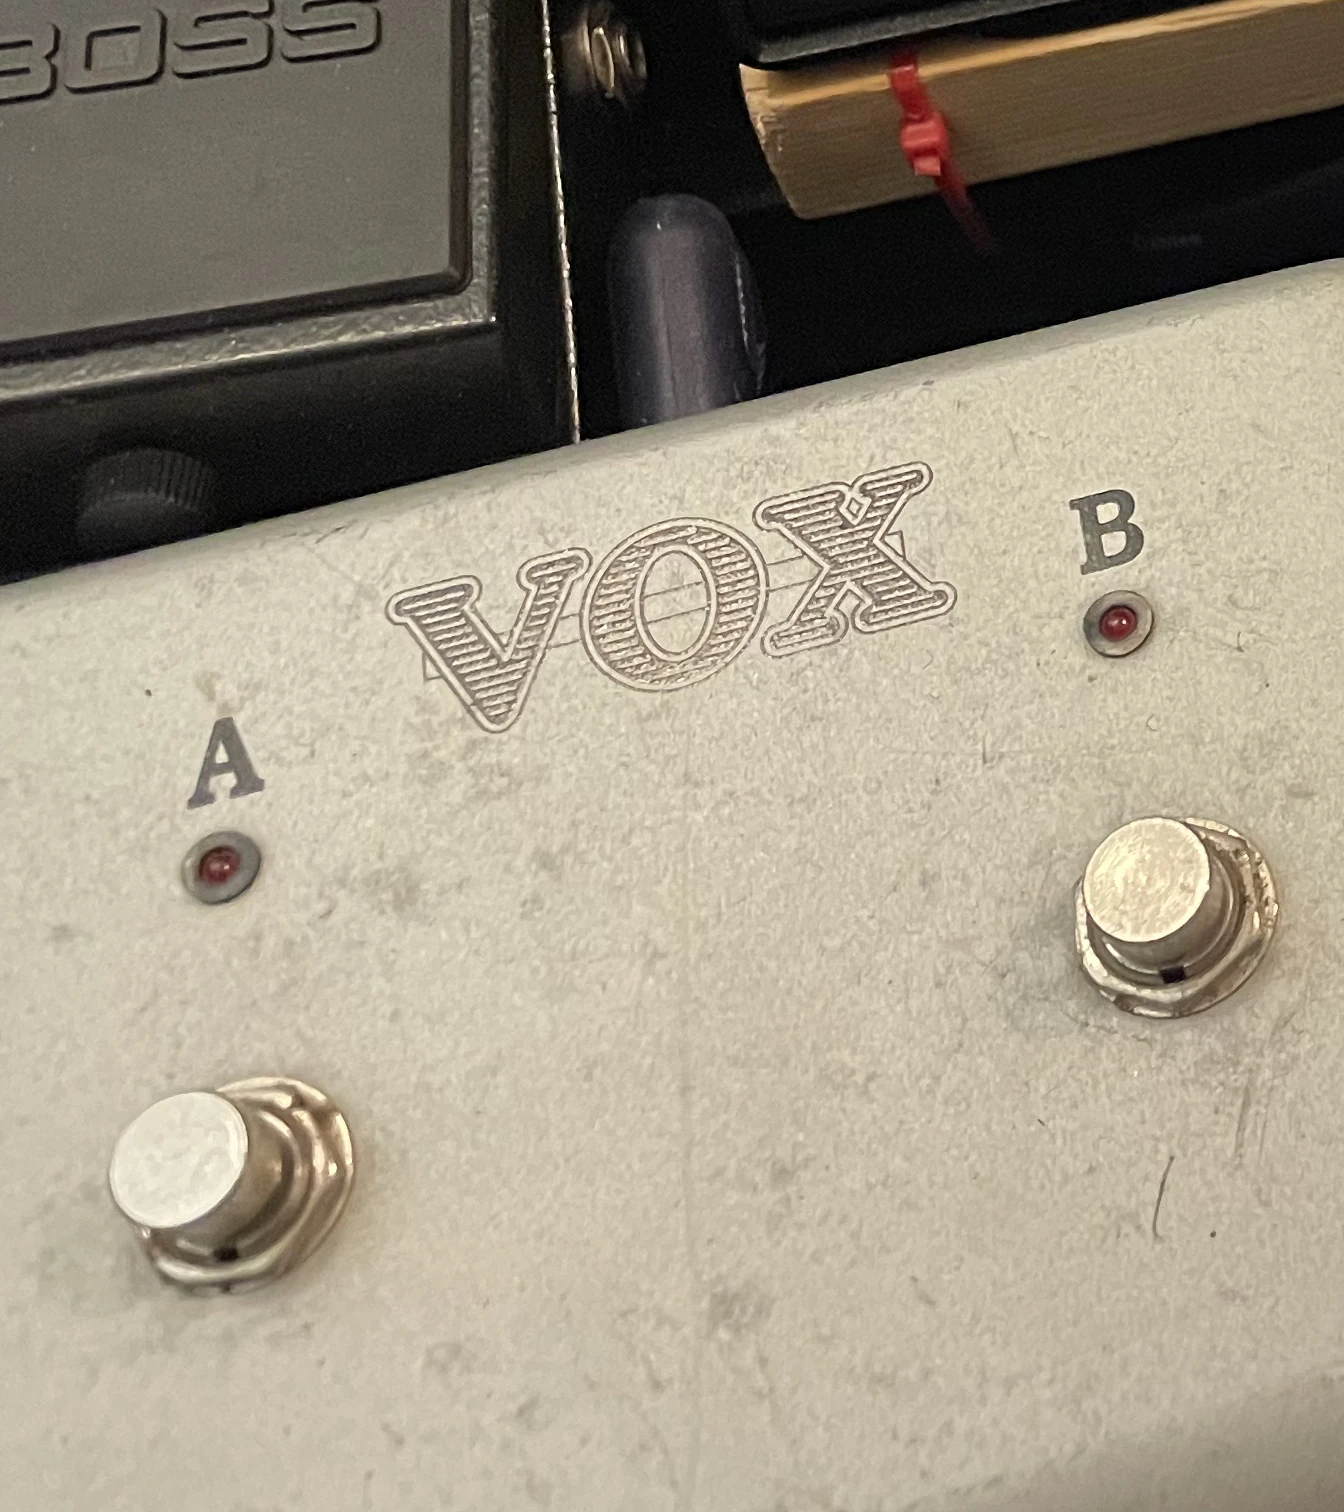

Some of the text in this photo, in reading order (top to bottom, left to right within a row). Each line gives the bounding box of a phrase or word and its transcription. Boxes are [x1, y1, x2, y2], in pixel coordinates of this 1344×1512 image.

[1070, 488, 1146, 576] B
[384, 460, 958, 734] VOX
[186, 715, 266, 810] A
